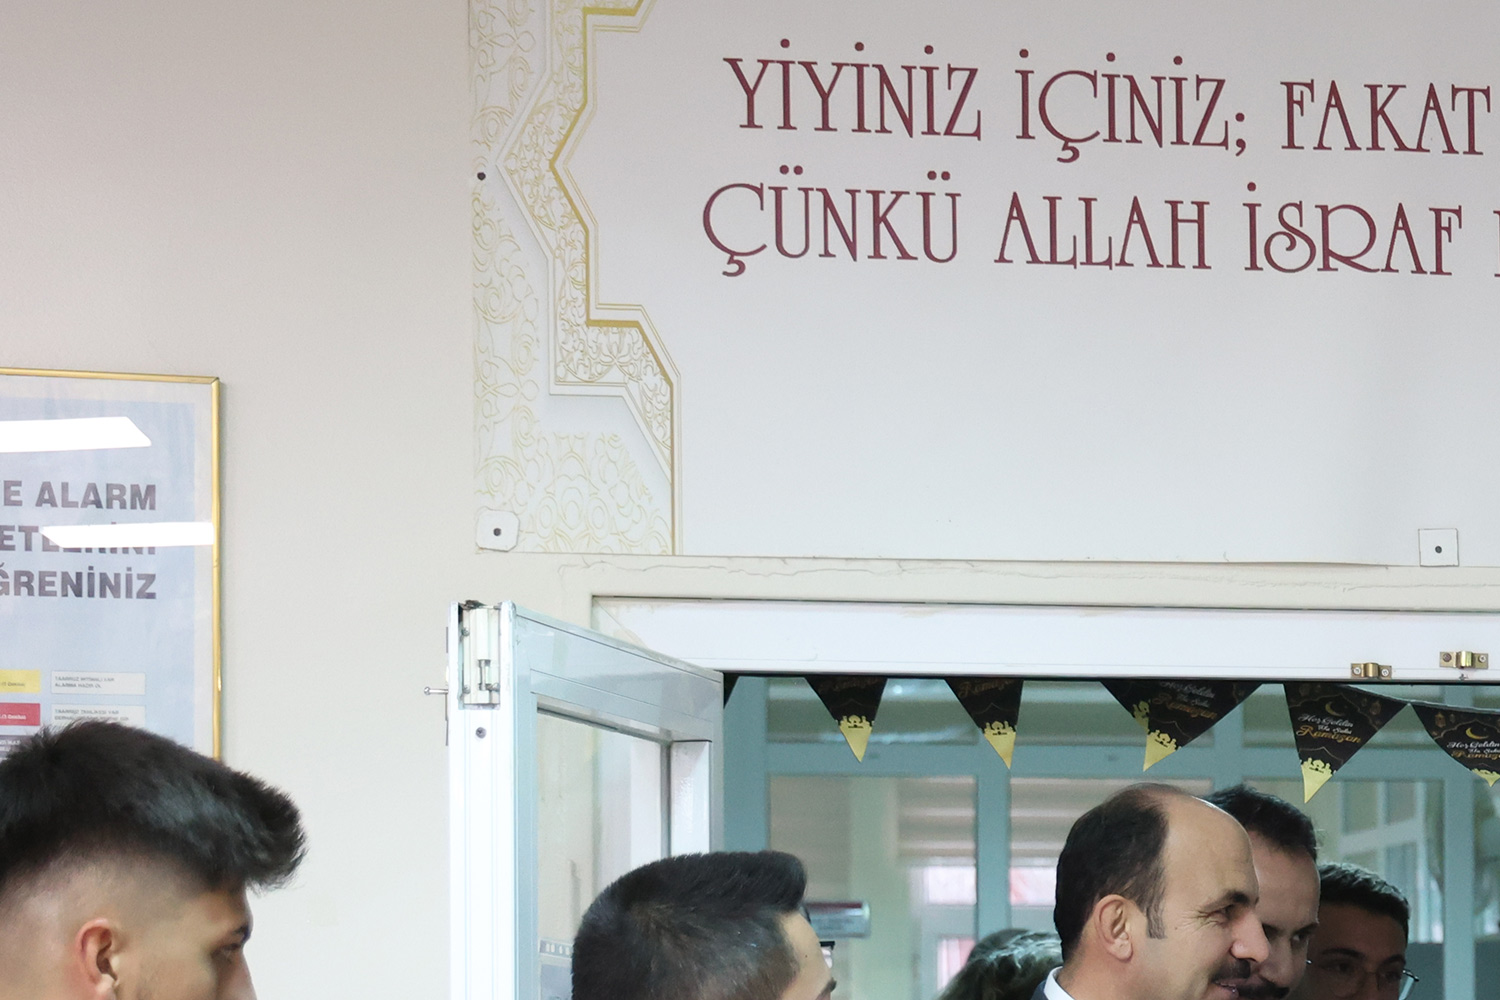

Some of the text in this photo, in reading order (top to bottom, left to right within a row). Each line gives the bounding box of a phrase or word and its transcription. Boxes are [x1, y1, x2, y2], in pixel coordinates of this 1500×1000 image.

[723, 39, 982, 142] YİYİNİZ
[1015, 49, 1247, 163] İÇİNİZ;
[1280, 79, 1491, 156] FAKAT
[703, 165, 962, 277] ÇÜNKÜ
[994, 192, 1212, 270] ALLAH
[1243, 182, 1463, 276] İSRAF
[0, 480, 156, 511] E ALARM
